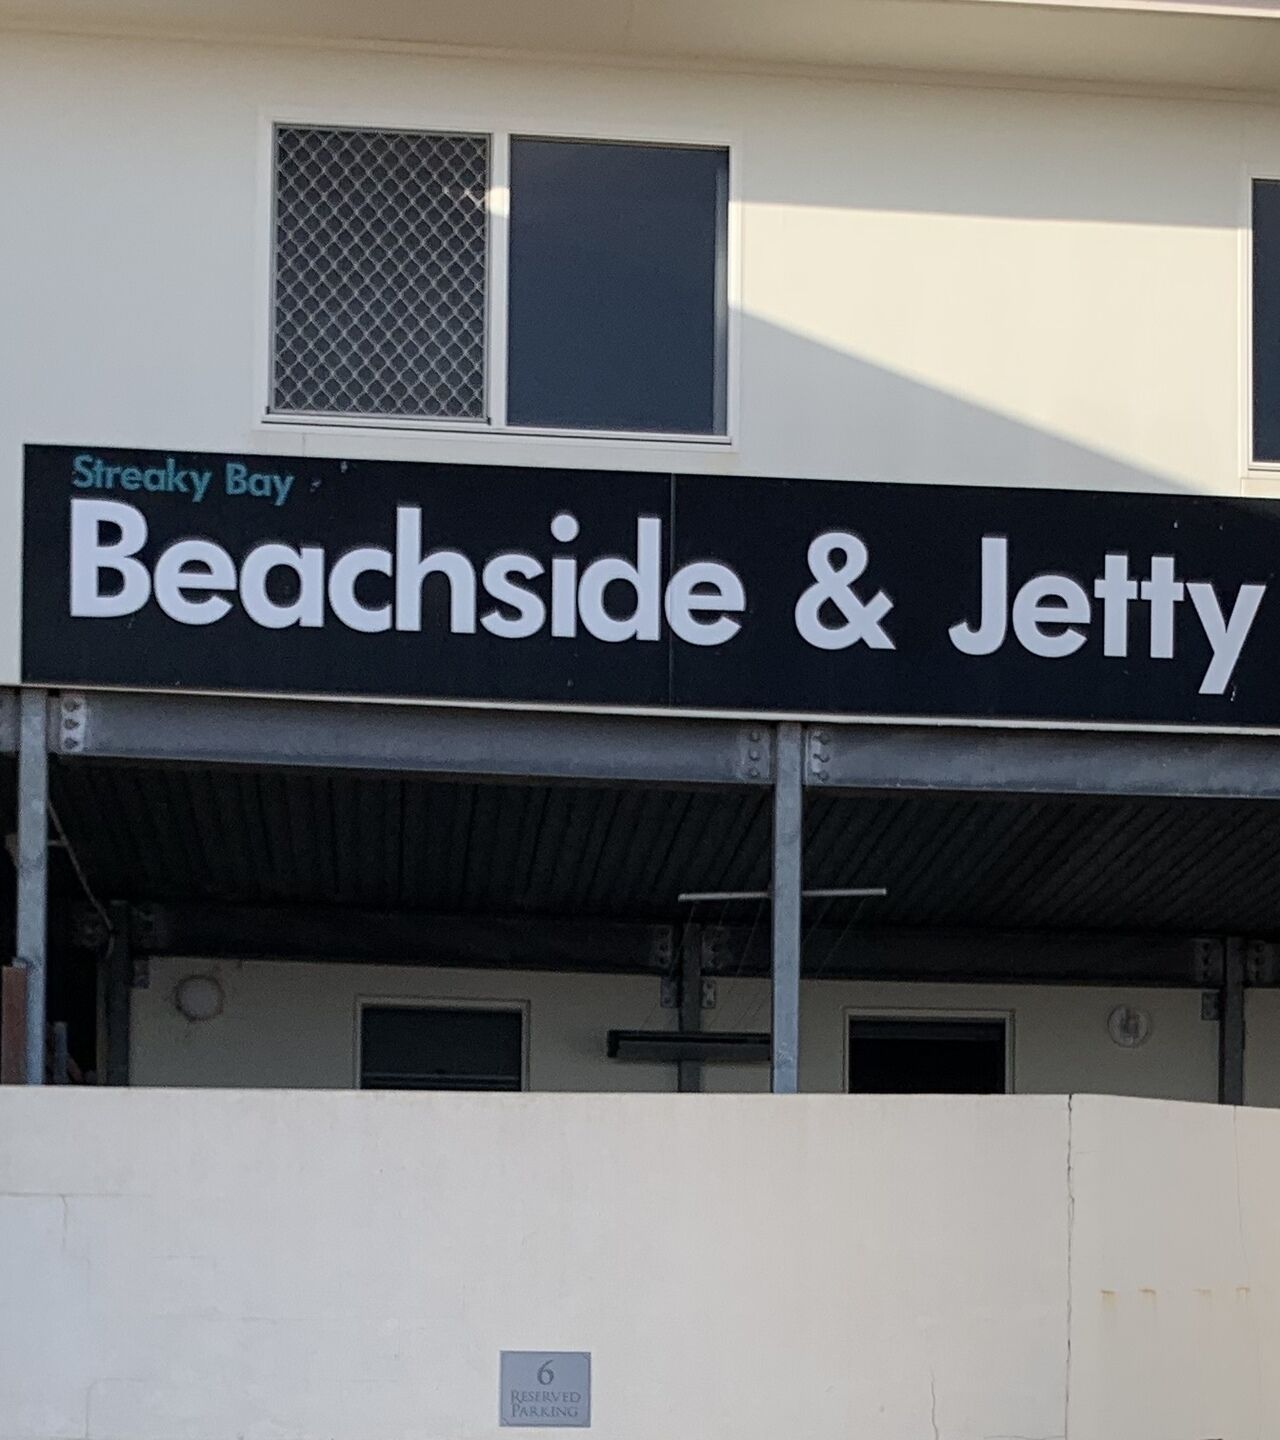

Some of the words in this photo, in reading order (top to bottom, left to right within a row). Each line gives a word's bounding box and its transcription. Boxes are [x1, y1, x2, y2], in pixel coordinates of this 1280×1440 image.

[72, 454, 213, 503] Streaky
[225, 462, 295, 507] Bay
[70, 497, 747, 647] Beachside
[794, 530, 897, 652] &
[948, 535, 1267, 695] Jetty
[536, 1359, 555, 1386] 6
